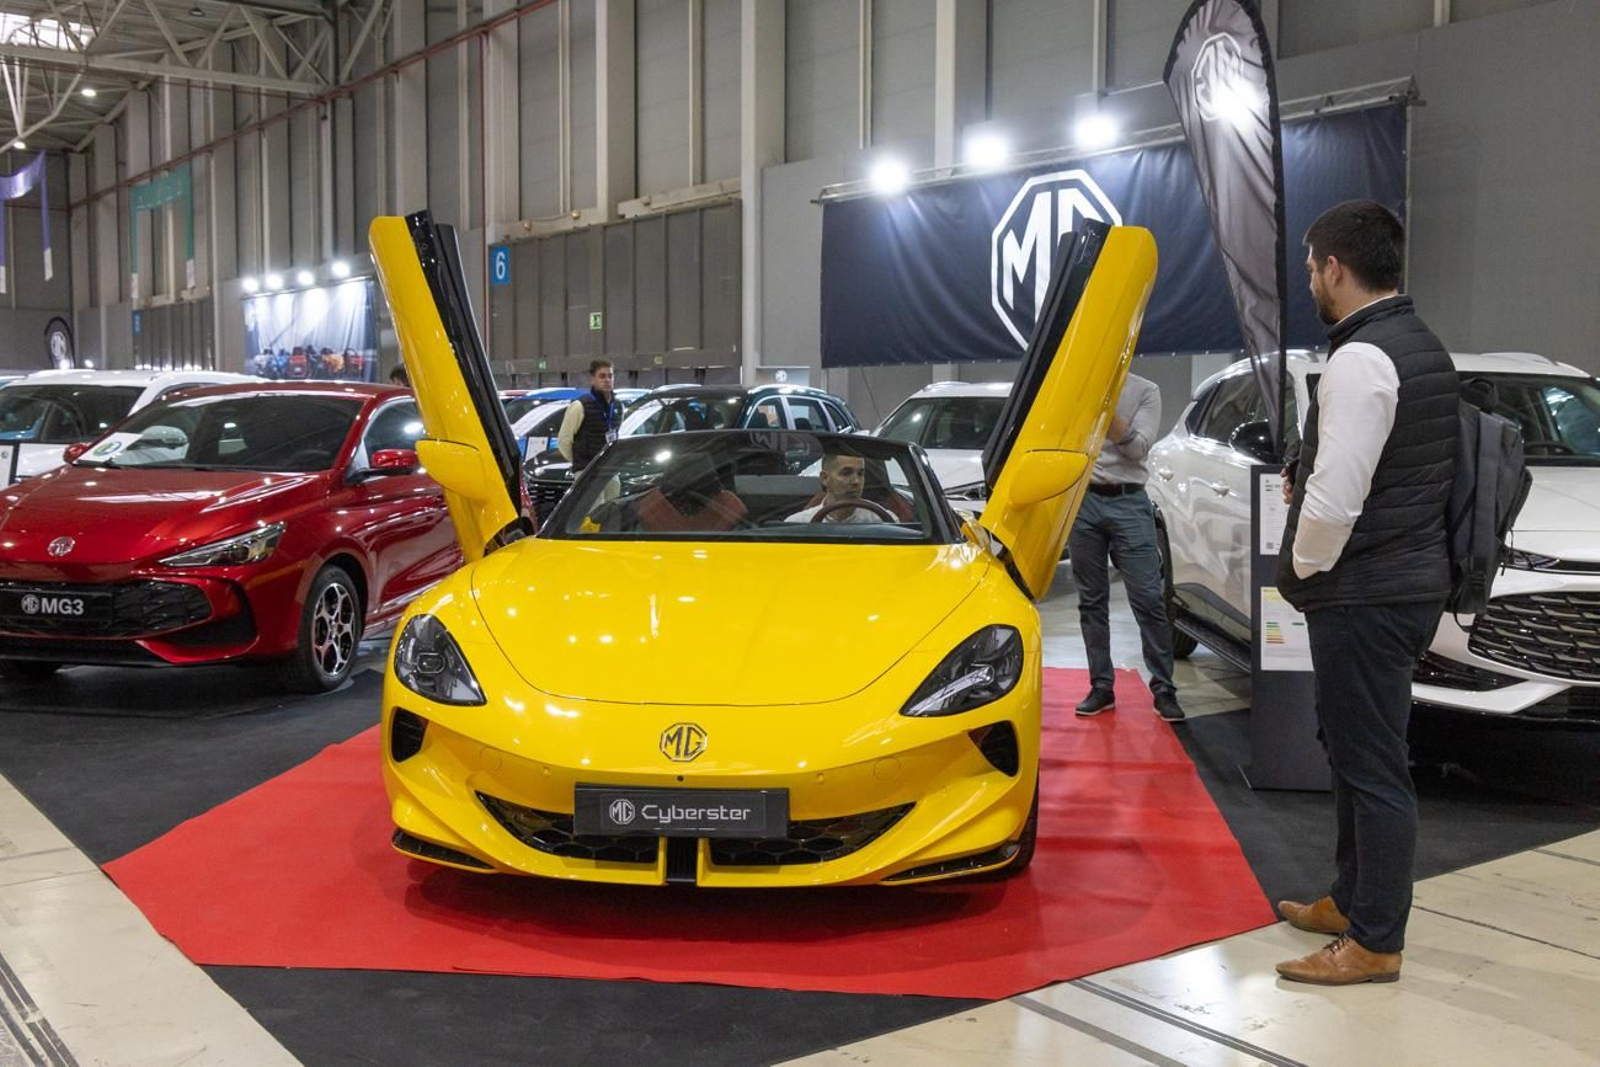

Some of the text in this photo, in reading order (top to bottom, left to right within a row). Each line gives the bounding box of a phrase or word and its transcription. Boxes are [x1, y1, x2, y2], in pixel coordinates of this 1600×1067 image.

[496, 251, 505, 280] 6
[41, 597, 84, 615] MG3
[663, 726, 704, 759] MG
[611, 801, 751, 824] MG Cyberster
